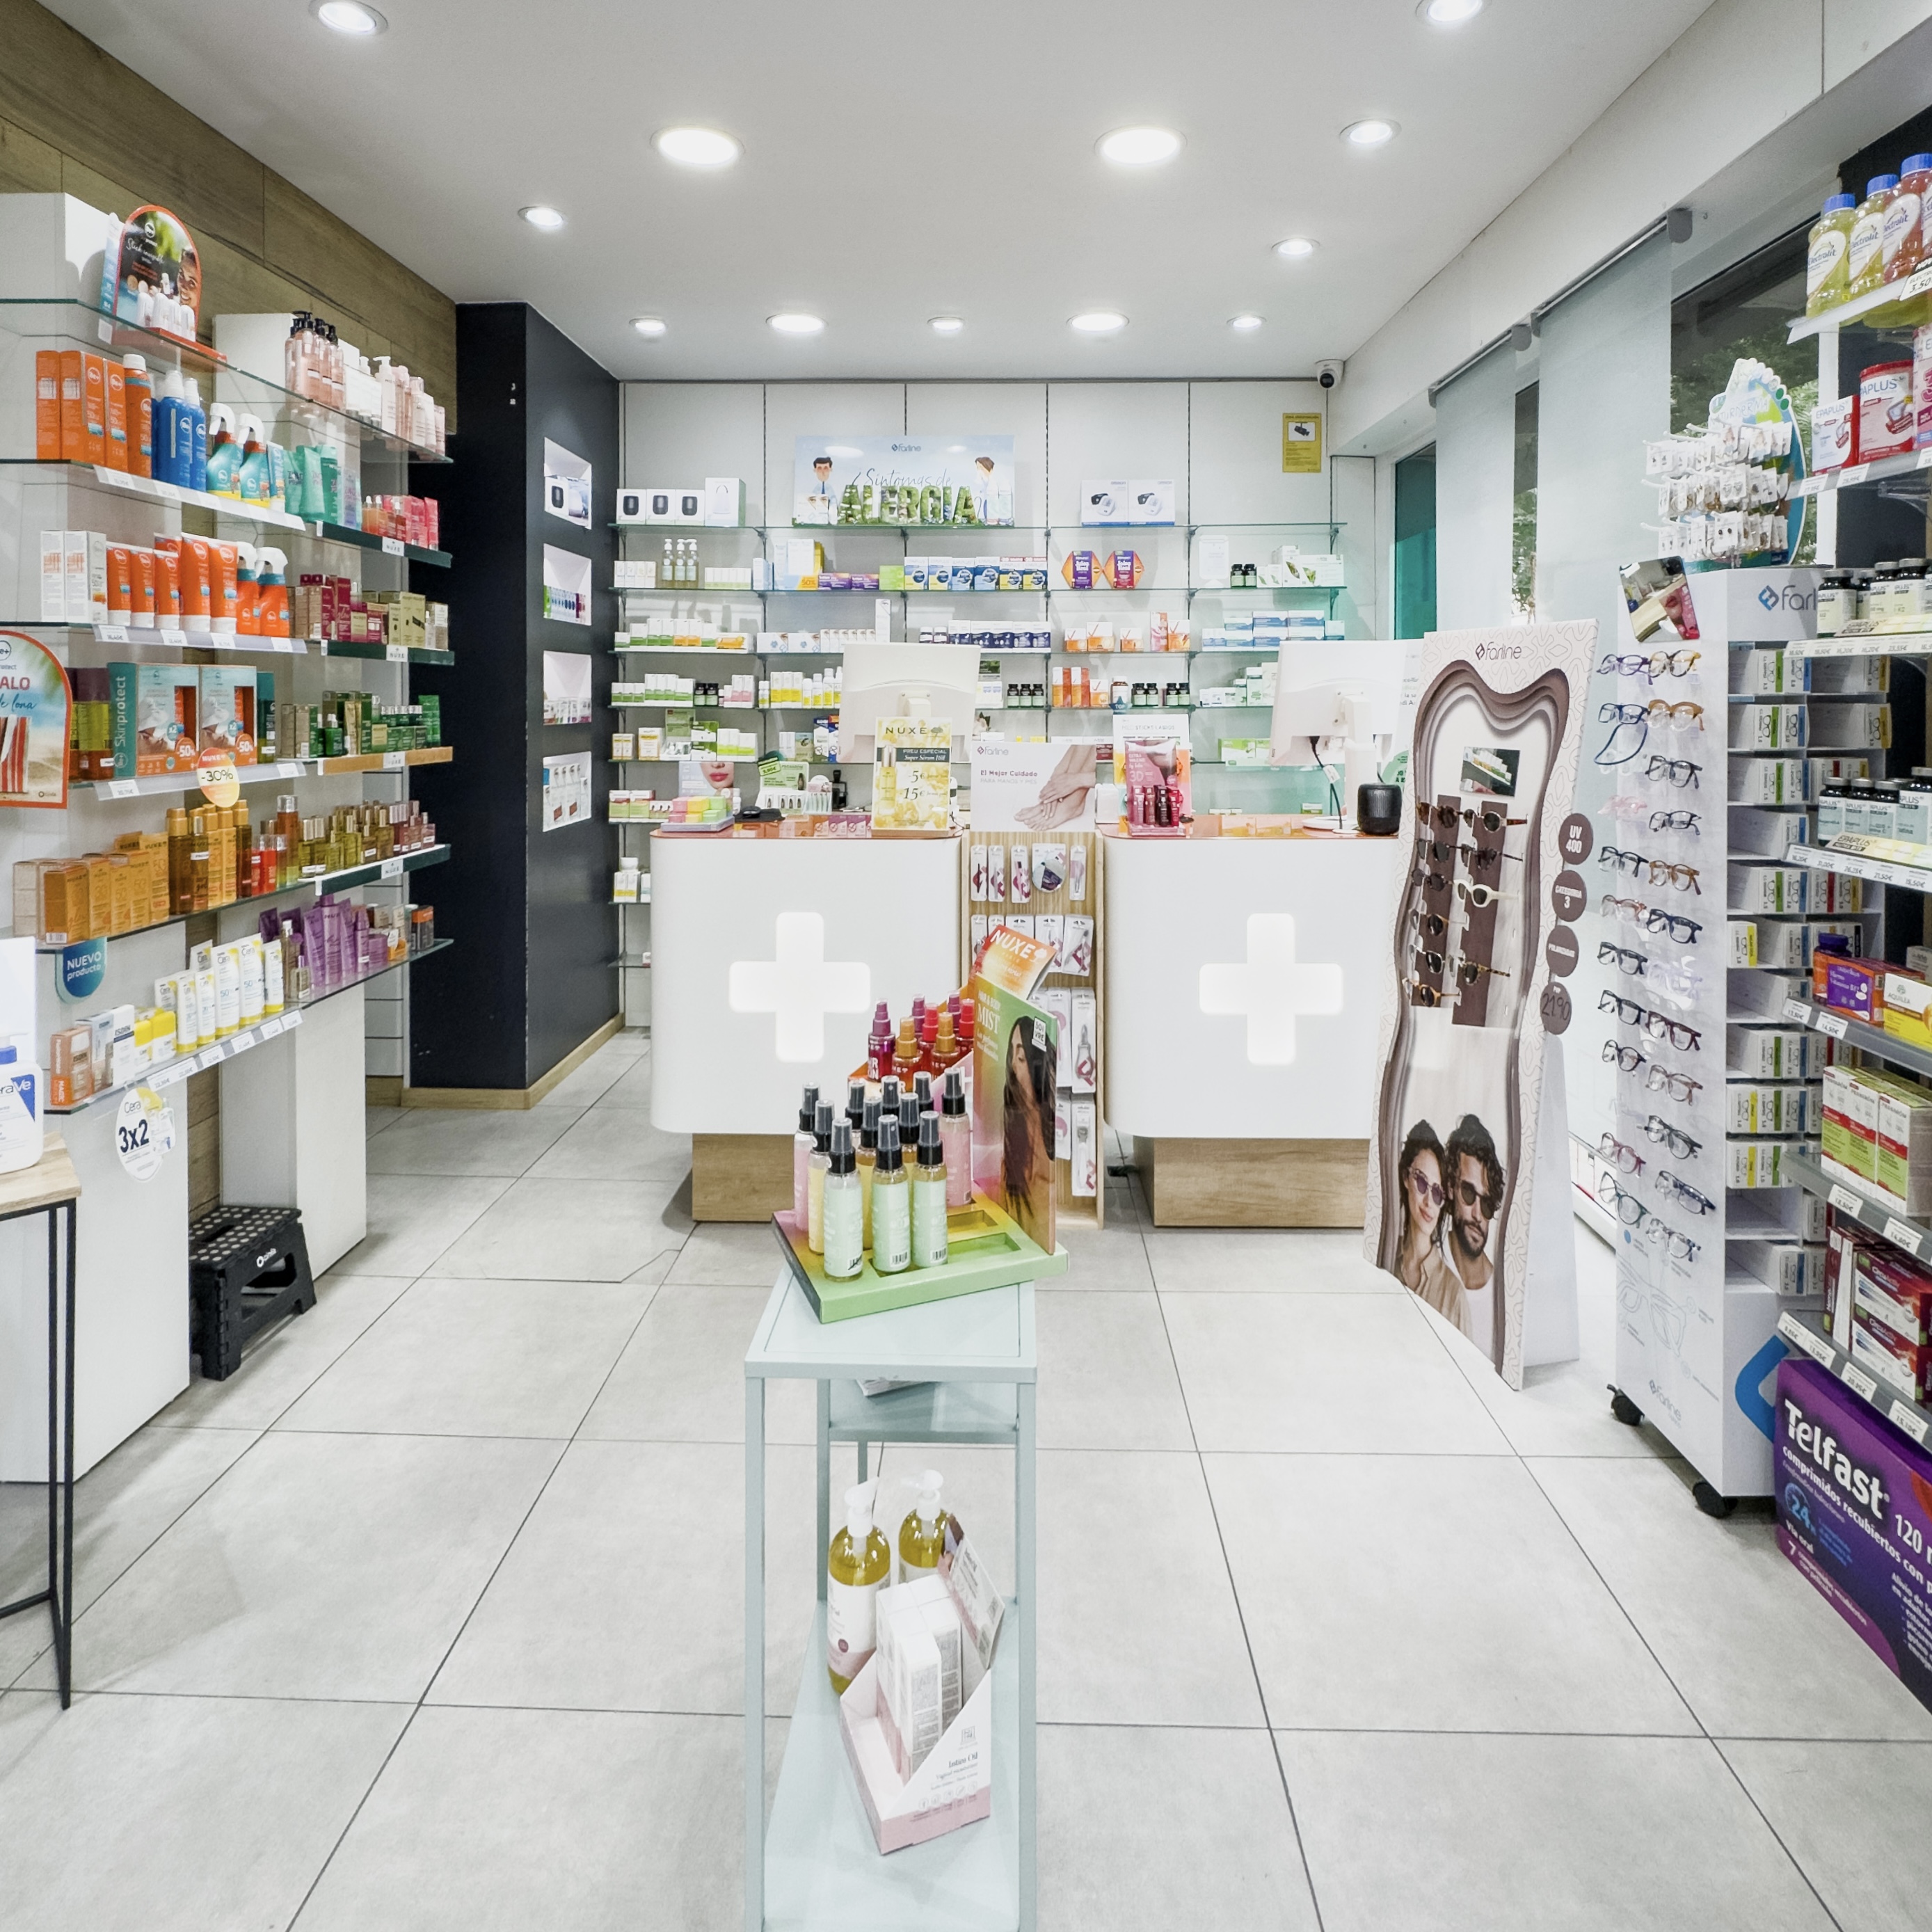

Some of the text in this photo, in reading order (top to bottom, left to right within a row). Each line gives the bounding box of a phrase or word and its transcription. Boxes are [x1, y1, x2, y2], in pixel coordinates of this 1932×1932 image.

[1883, 214, 1909, 231] lectrolit
[1808, 246, 1837, 265] Electrolit
[1860, 379, 1898, 397] PAPLUS
[1816, 402, 1845, 419] EPAPLUS
[1781, 585, 1816, 610] farl
[1485, 641, 1522, 660] farline
[12, 693, 38, 712] lona
[114, 676, 127, 747] Skinprotect
[984, 746, 1009, 756] farline
[201, 768, 234, 782] -30%
[1130, 770, 1144, 783] 3D
[1899, 795, 1920, 804] PLUS
[1570, 824, 1583, 839] UV
[1565, 839, 1583, 854] 400
[1564, 895, 1571, 909] 3
[990, 929, 1036, 959] NUXE
[67, 951, 102, 970] NUEVO
[67, 963, 102, 982] producto
[1887, 993, 1911, 1004] AQUILEA
[977, 1003, 1000, 1035] MIST
[118, 1119, 150, 1153] 3x2
[1785, 1399, 1883, 1519] Telfast
[1894, 1514, 1923, 1555] 120
[1782, 1445, 1842, 1506] comprimidos
[1843, 1501, 1901, 1564] recubiertos
[1903, 1556, 1924, 1586] con
[1787, 1539, 1796, 1557] 7
